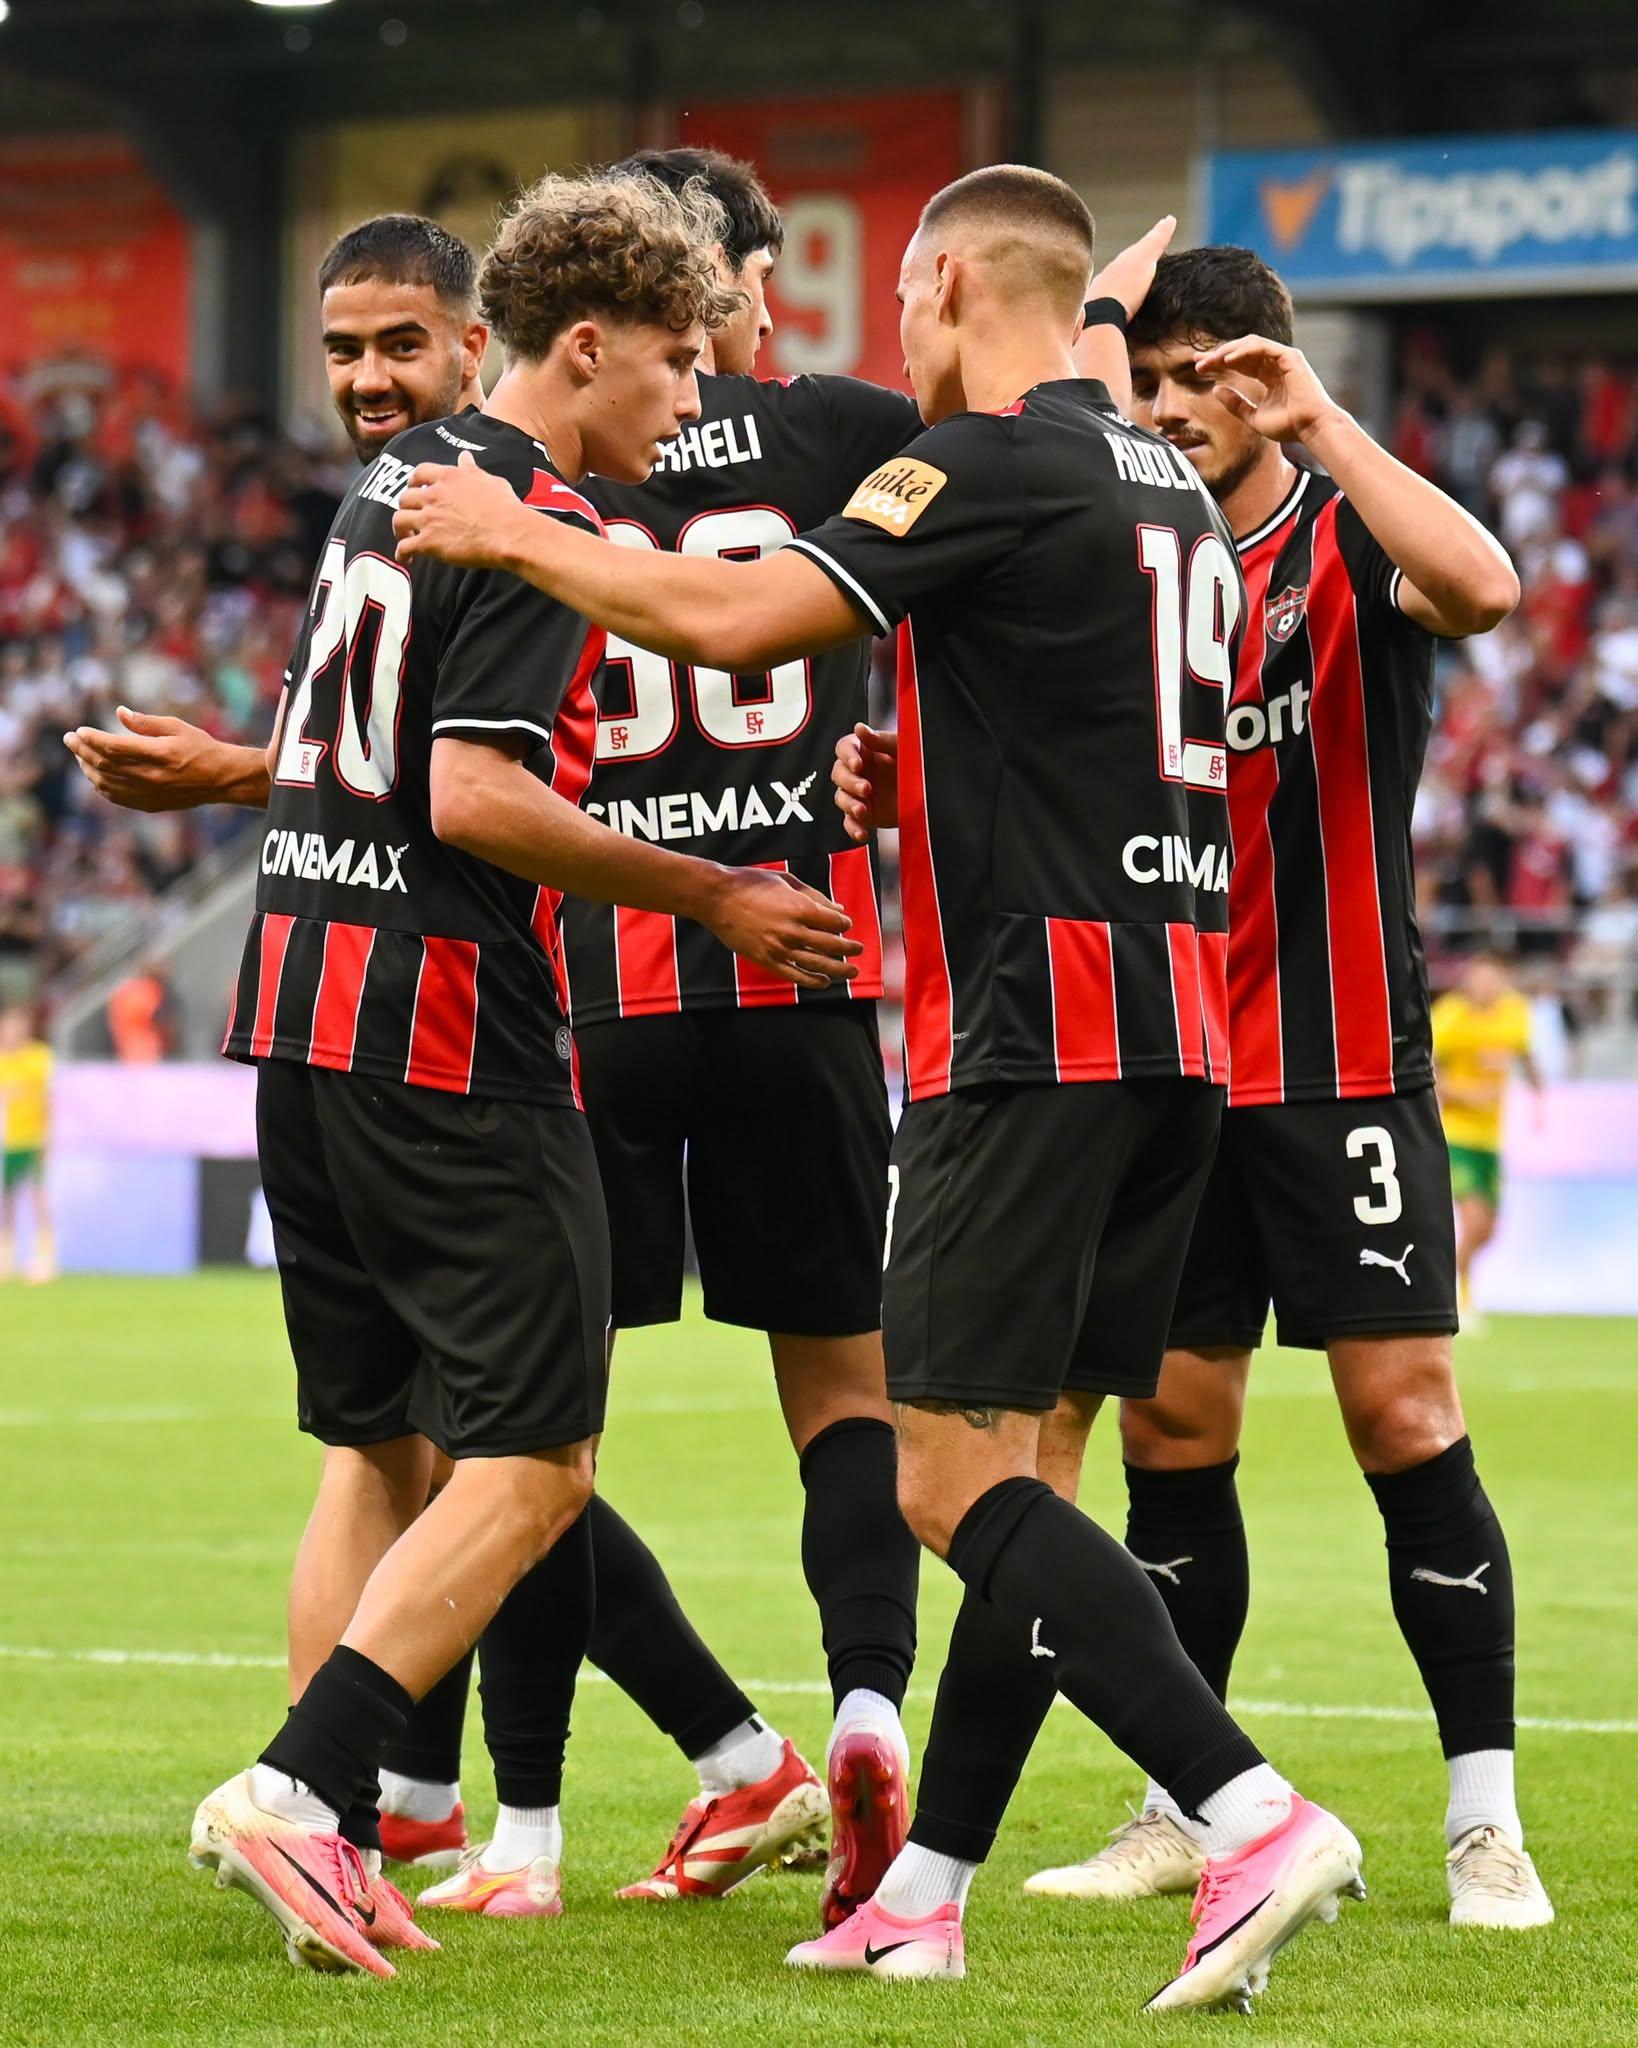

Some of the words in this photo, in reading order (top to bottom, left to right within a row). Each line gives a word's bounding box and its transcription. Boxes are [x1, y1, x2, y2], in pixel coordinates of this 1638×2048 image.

[1337, 151, 1635, 265] Tipsport
[768, 192, 867, 375] 9
[274, 537, 413, 803] 20
[1136, 523, 1242, 795] 19
[1226, 680, 1310, 751] ort
[262, 828, 410, 893] CINEMAX
[1122, 834, 1229, 893] CINMA
[1346, 1126, 1402, 1225] 3
